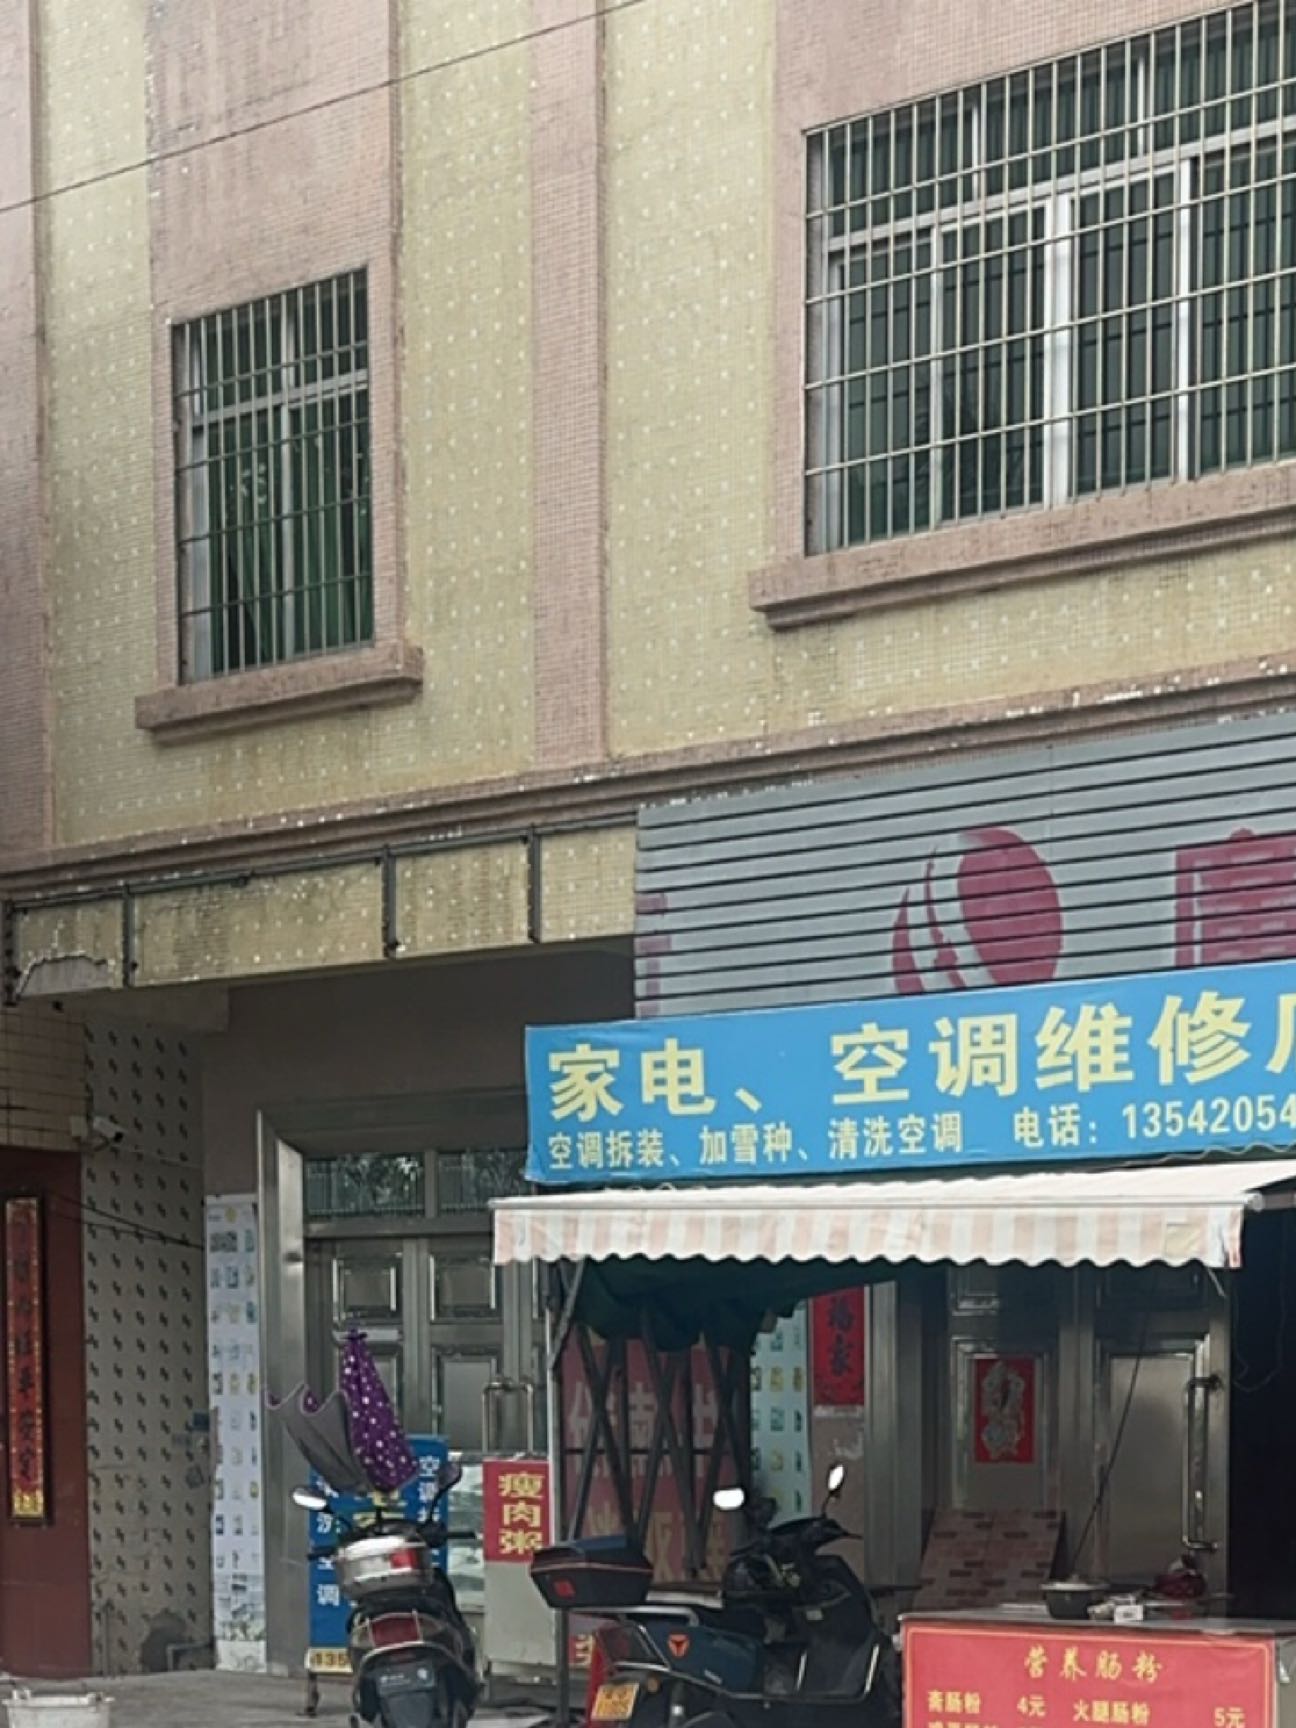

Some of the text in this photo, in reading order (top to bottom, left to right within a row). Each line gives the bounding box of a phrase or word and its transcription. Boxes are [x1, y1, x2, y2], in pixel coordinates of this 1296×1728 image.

[498, 1471, 545, 1555] 瘦肉粥
[1024, 1643, 1163, 1685] 营养肠粉
[1016, 1694, 1047, 1717] 4元
